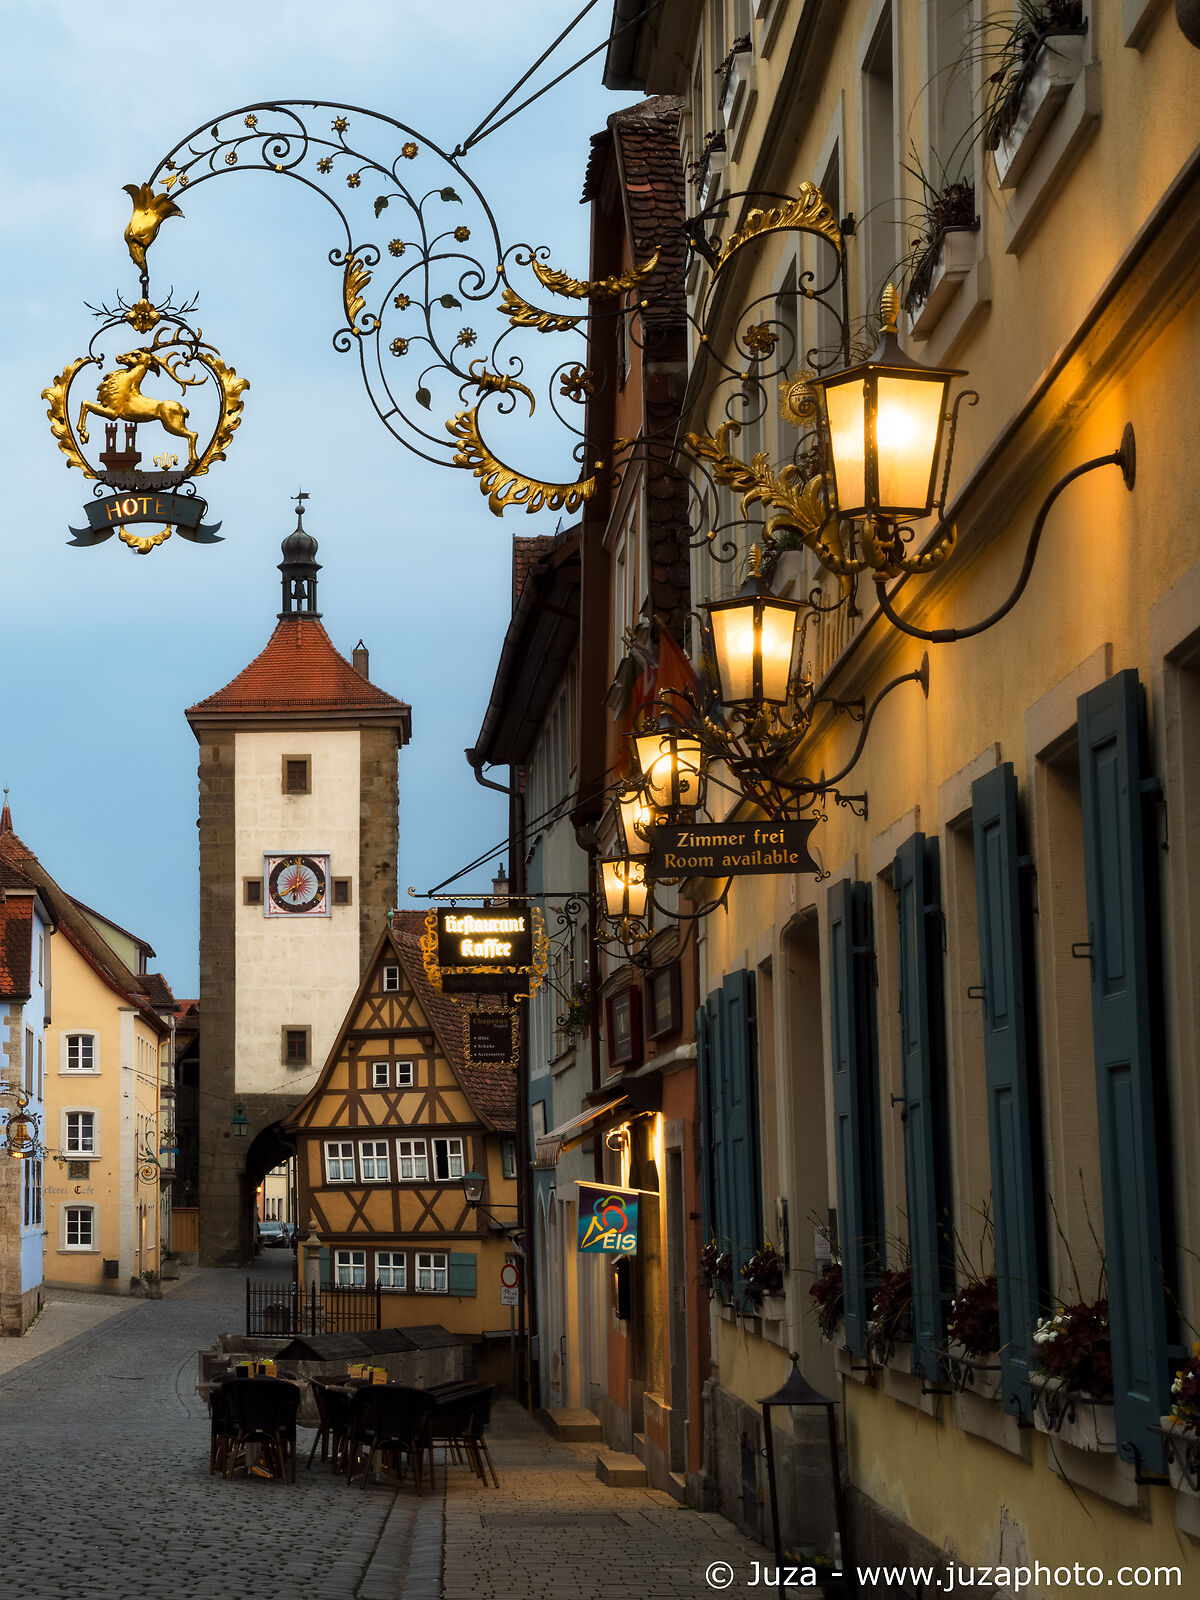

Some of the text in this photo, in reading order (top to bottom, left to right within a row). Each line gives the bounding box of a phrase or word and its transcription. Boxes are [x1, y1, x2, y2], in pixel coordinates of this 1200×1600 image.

[105, 497, 181, 521] HOTEL
[676, 829, 785, 848] Zimmer frei
[664, 849, 800, 869] Room available
[444, 914, 526, 935] Restaurant
[461, 938, 512, 959] Kaffee
[603, 1233, 636, 1250] EIS
